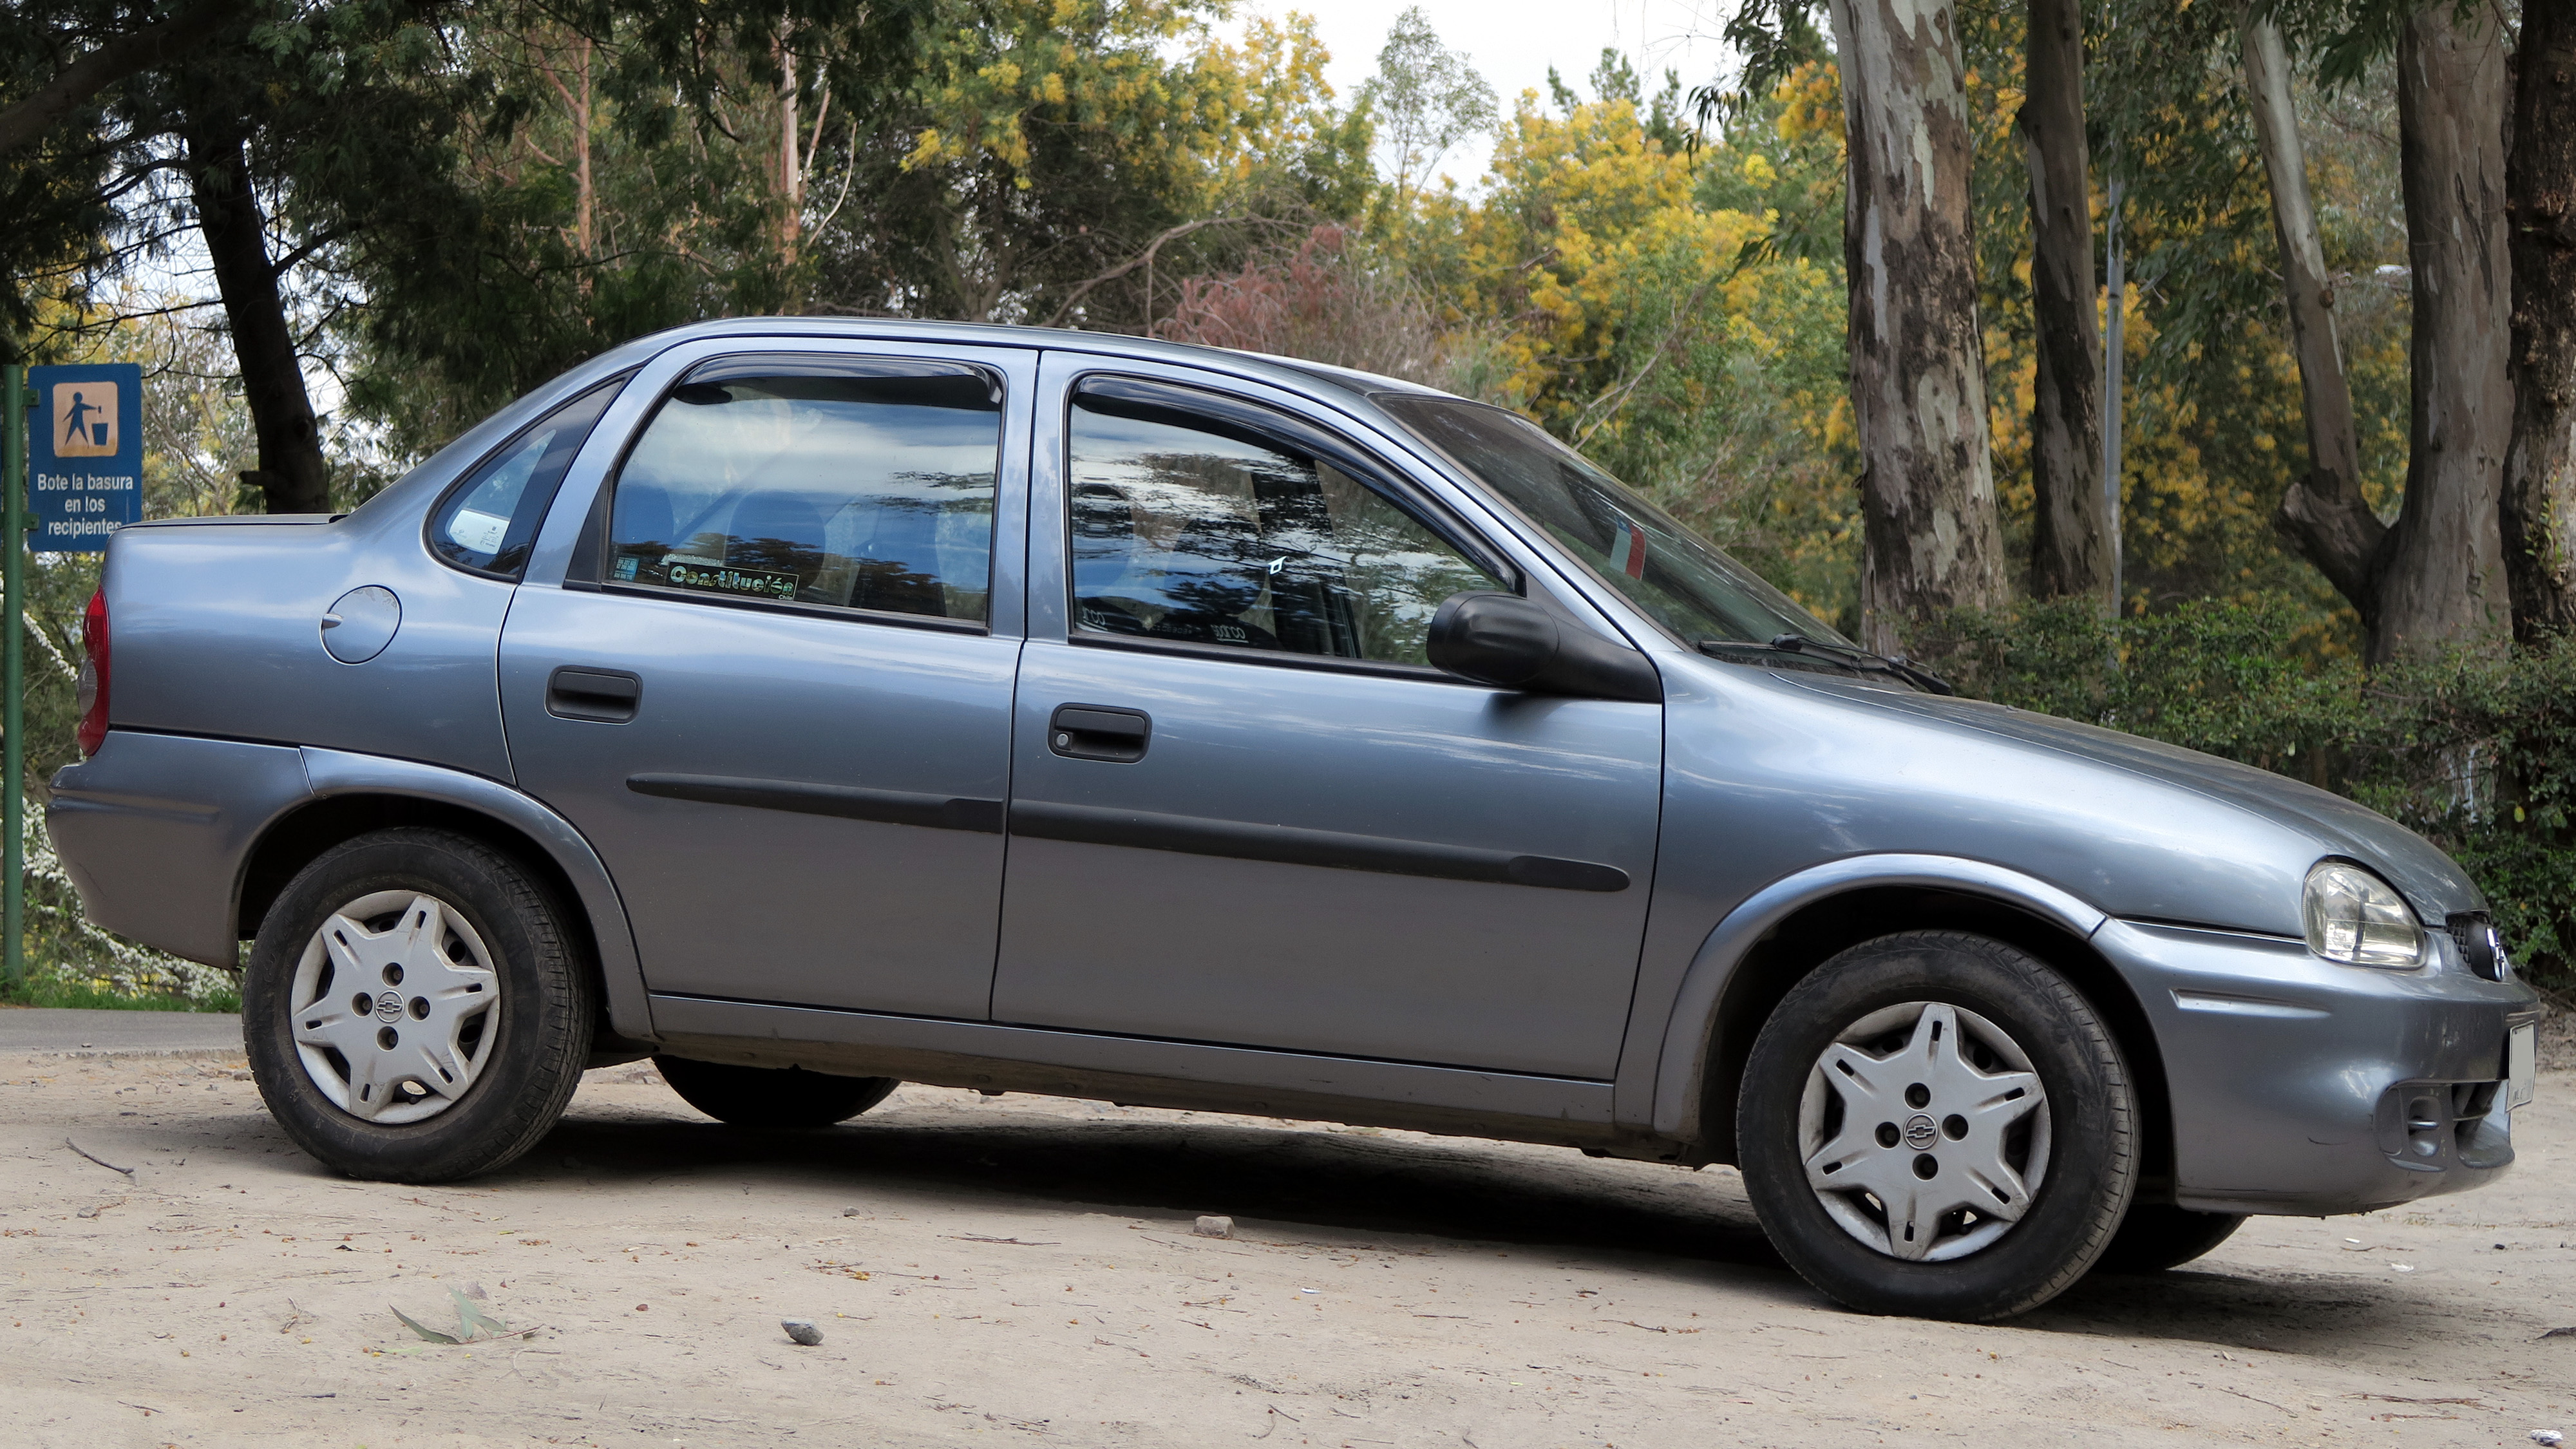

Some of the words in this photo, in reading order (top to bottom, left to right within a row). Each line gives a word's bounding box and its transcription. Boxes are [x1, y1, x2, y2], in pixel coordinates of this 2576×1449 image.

[37, 473, 68, 491] Bote
[72, 473, 83, 491] la
[88, 473, 133, 490] basura
[65, 498, 80, 513] en
[85, 496, 106, 513] los
[670, 565, 794, 596] Constitución
